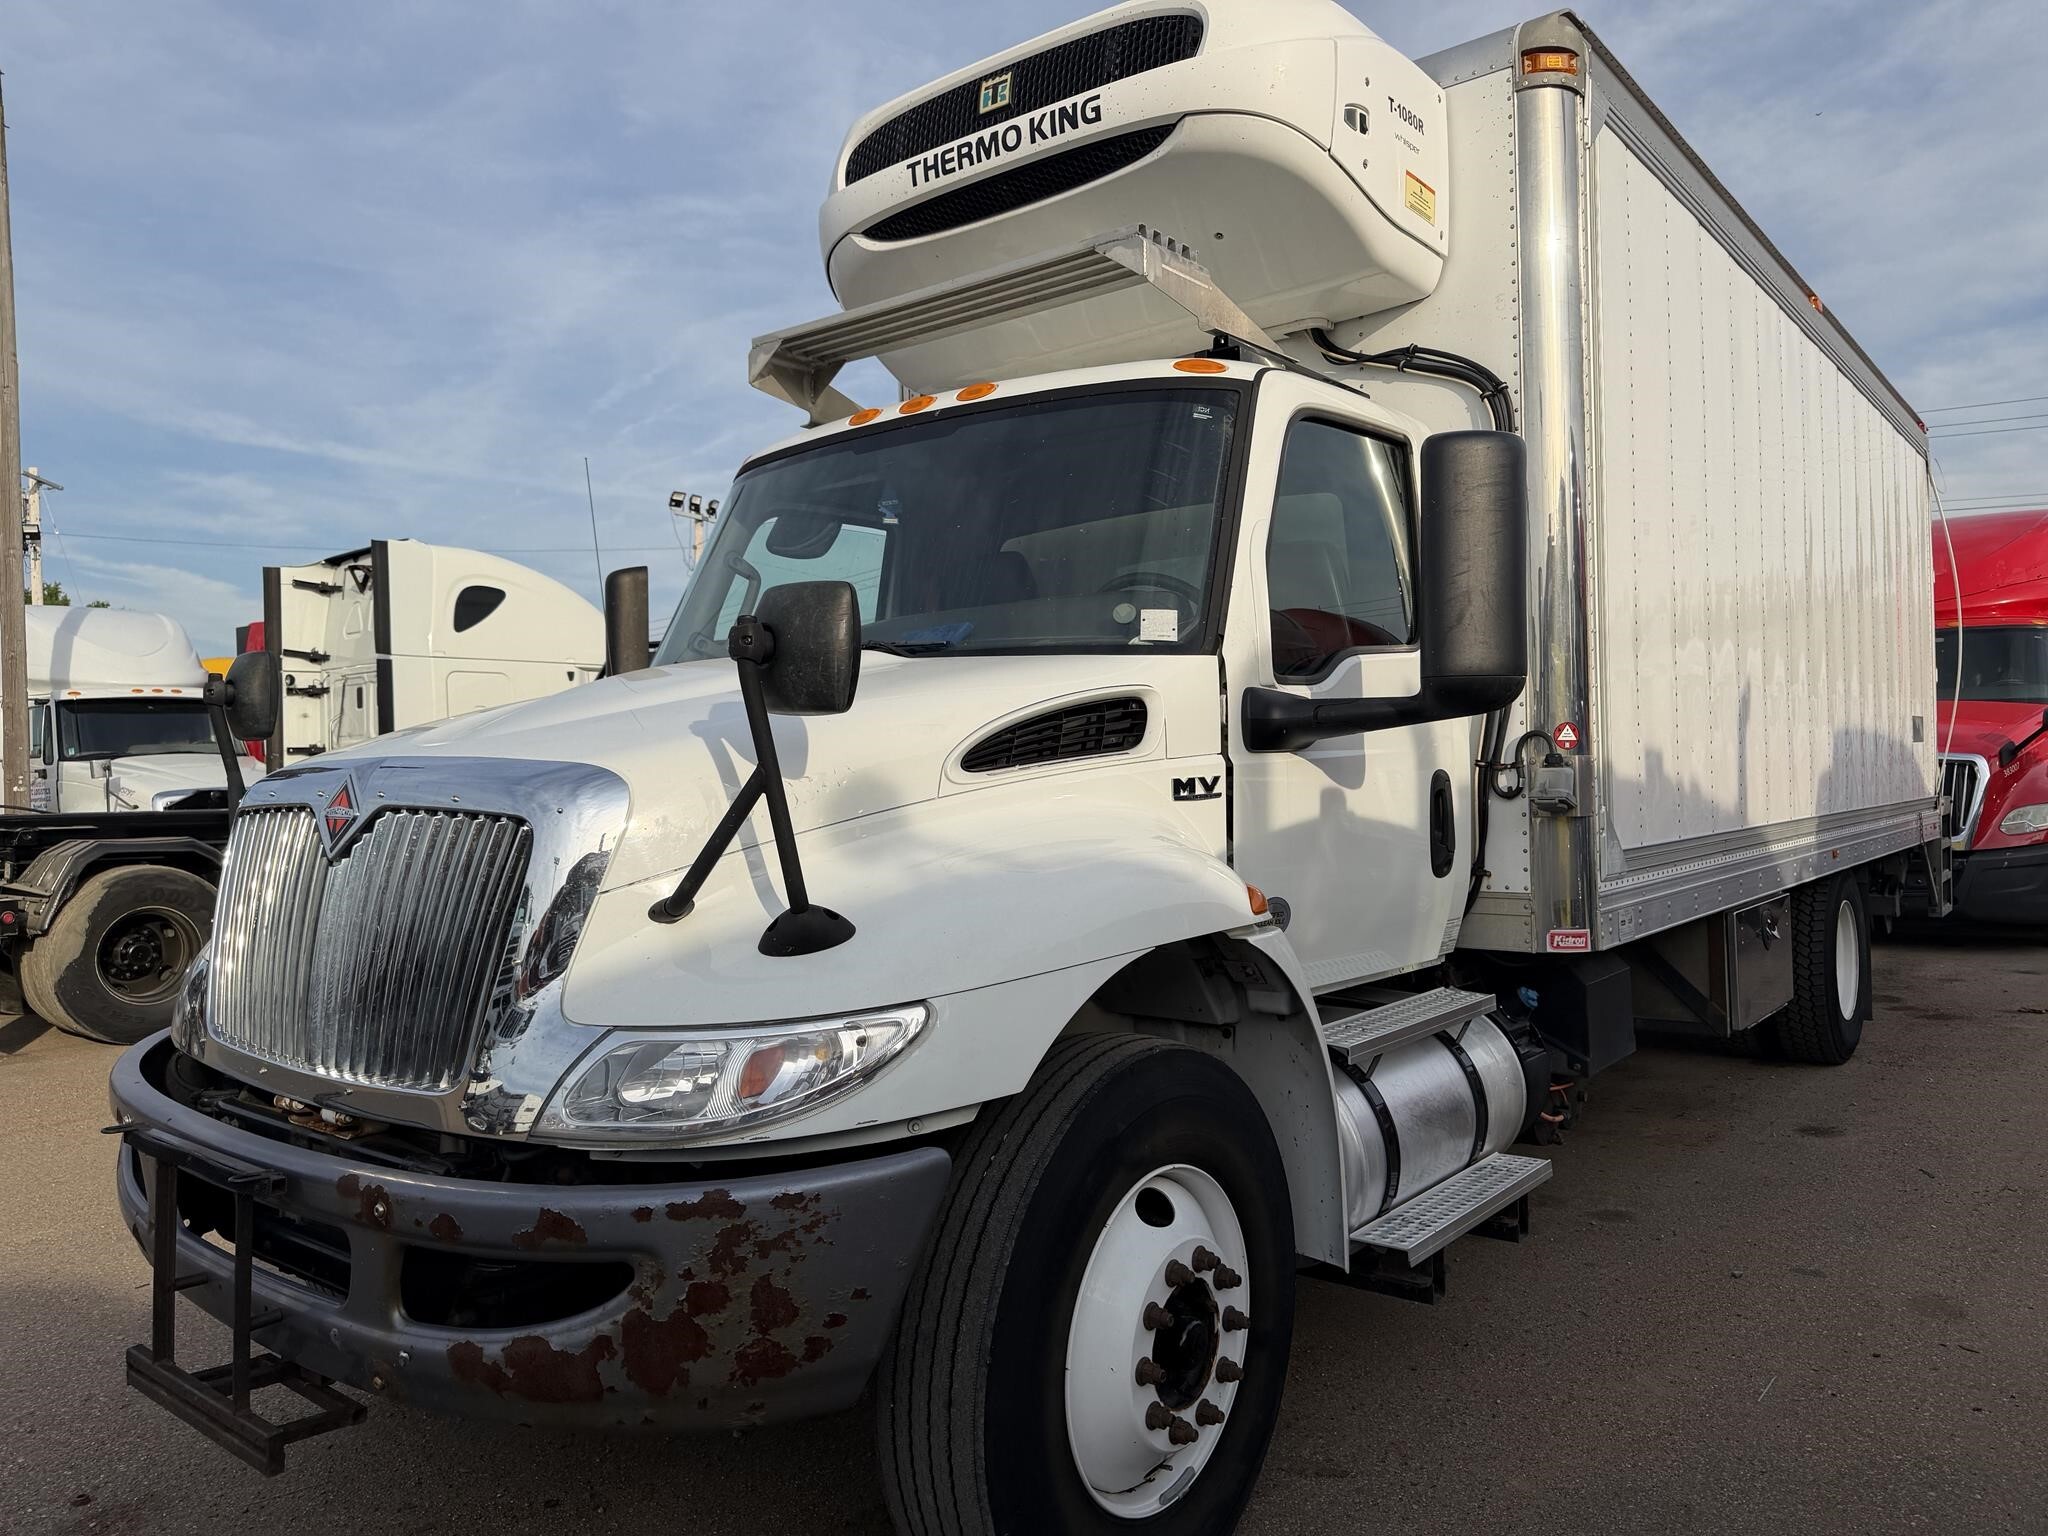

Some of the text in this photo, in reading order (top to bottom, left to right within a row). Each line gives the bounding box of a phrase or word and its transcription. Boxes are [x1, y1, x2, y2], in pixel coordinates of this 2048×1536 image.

[1388, 95, 1425, 136] T-1080R
[906, 94, 1102, 188] THERMO KING
[1173, 776, 1221, 796] MV
[1553, 935, 1586, 947] Kidron
